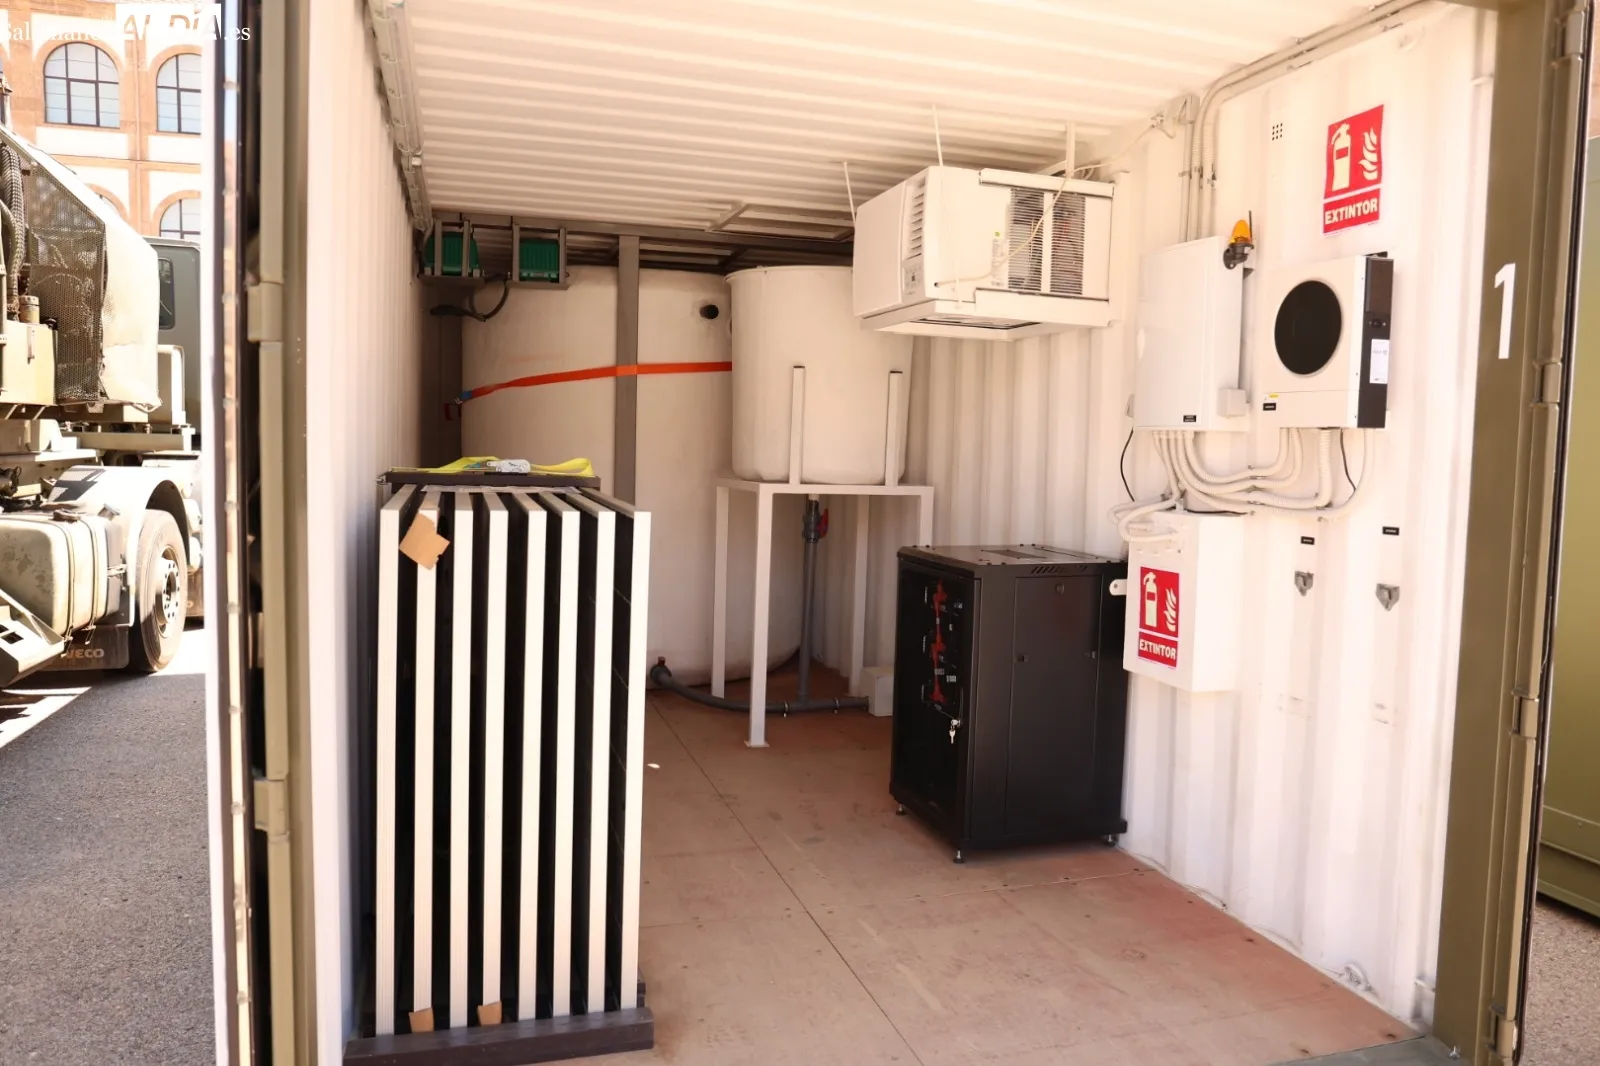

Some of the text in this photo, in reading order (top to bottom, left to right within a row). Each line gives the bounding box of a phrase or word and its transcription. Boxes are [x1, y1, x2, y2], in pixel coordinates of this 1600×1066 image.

[1325, 197, 1378, 225] EXTINTOR
[1494, 262, 1516, 359] 1
[1139, 638, 1177, 660] EXTINTOR
